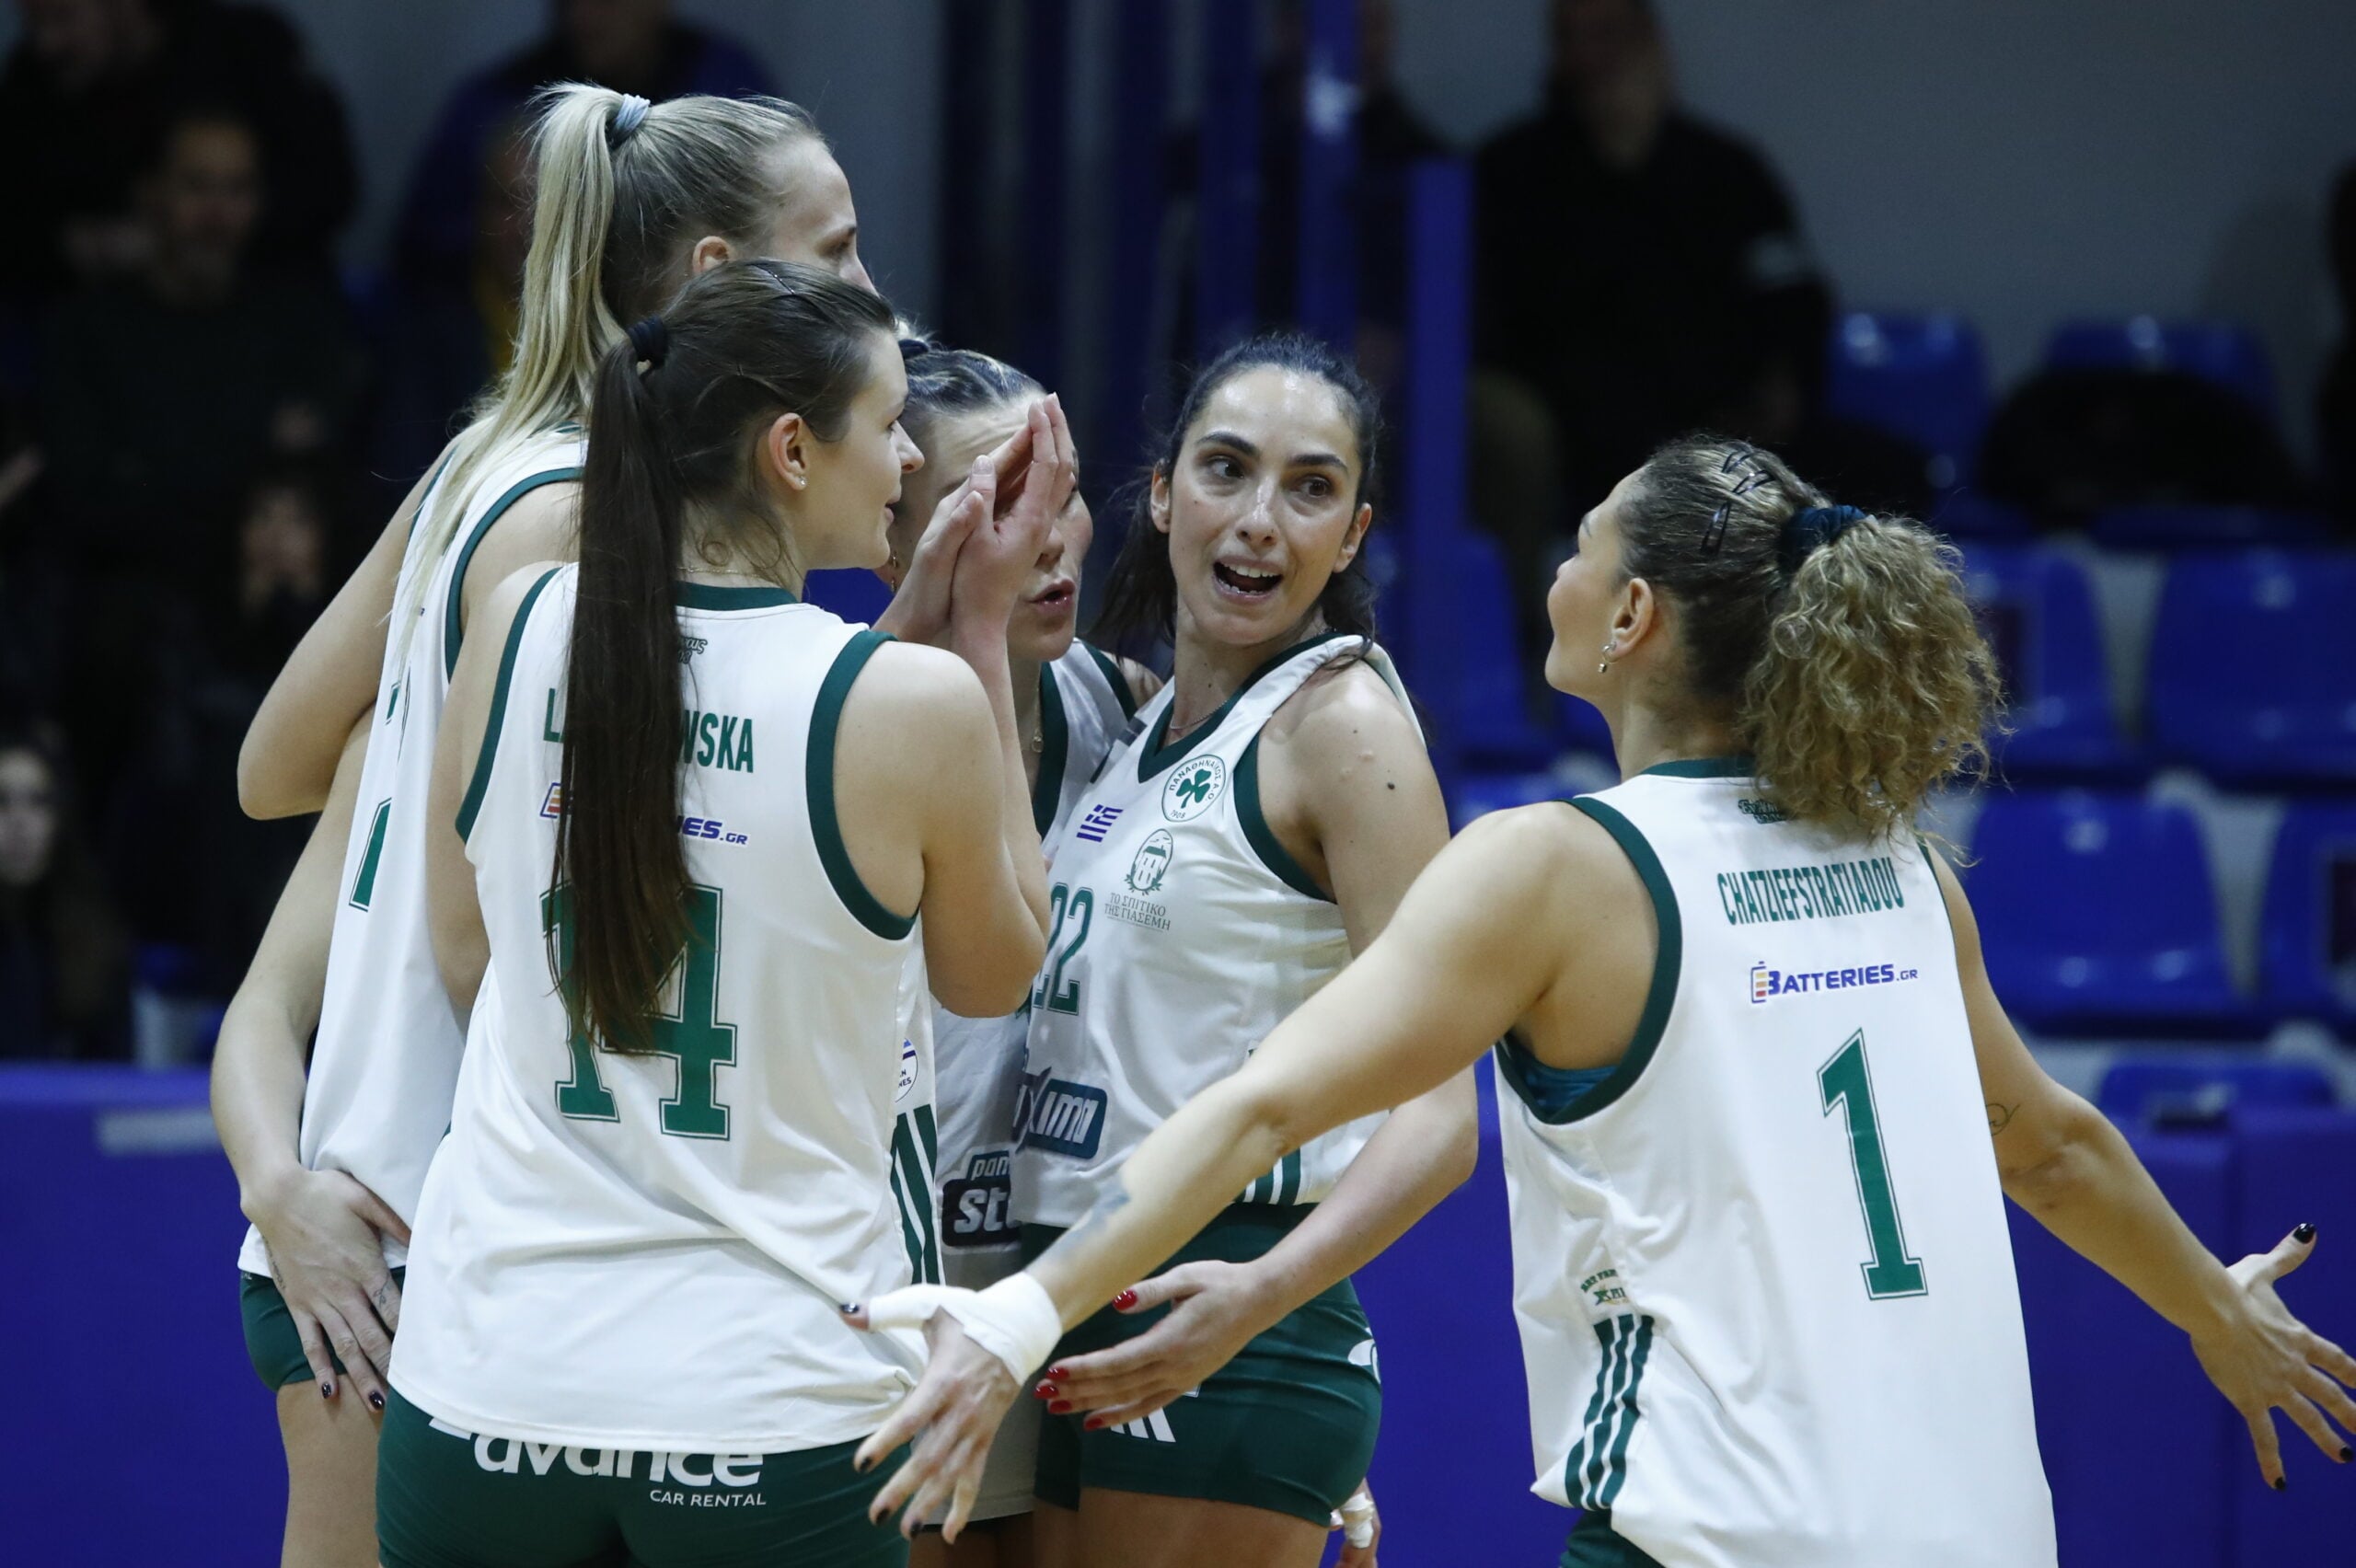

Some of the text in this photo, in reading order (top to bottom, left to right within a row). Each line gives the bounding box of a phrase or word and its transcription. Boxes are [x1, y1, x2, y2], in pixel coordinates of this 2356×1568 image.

[1716, 856, 1905, 926] CHATZIEFSTRATIADOU
[1121, 895, 1166, 917] ΣΠΙΤΙΚΟ
[1121, 908, 1172, 931] ΓΙΑΣΕΜΗ
[1817, 1027, 1929, 1301] 1
[650, 1489, 767, 1508] CAR RENTAL
